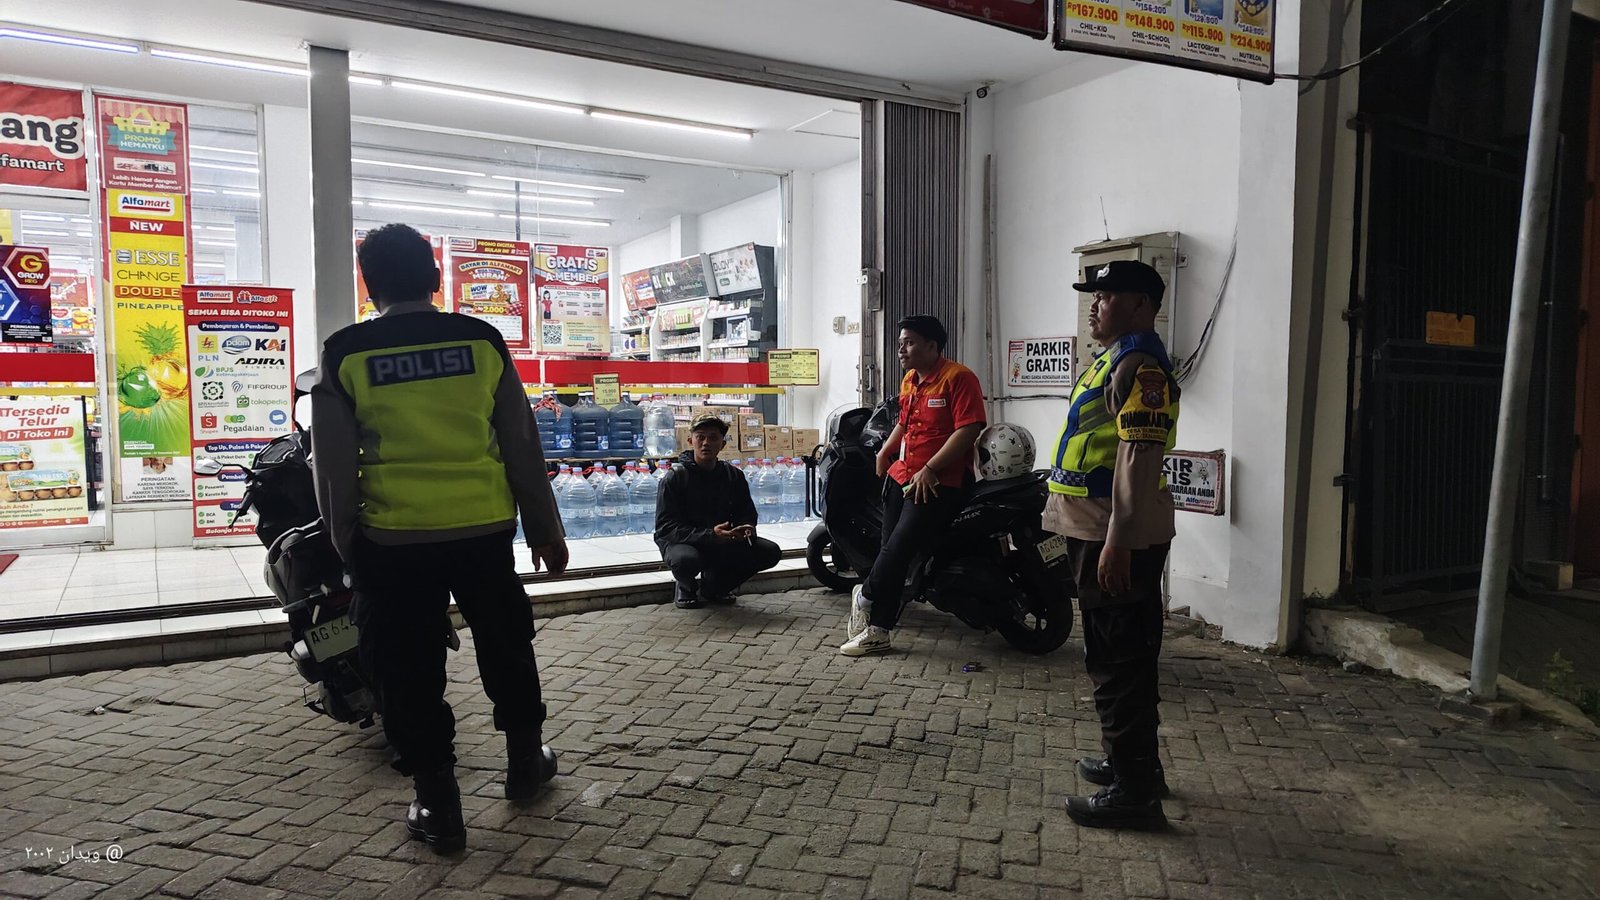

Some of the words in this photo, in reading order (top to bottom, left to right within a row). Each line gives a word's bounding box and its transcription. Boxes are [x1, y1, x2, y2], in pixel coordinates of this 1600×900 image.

[1067, 2, 1119, 22] Rp167.900
[1125, 12, 1175, 32] Rp148.900
[124, 134, 161, 143] PROMO
[120, 141, 165, 151] HEMATKU
[121, 196, 171, 208] Alfamart
[129, 220, 164, 232] NEW
[134, 249, 180, 267] ESSE
[546, 255, 598, 272] GRATIS
[17, 272, 45, 280] GROW
[116, 269, 181, 282] CHANGE
[119, 286, 180, 297] DOUBLE
[117, 302, 184, 311] PINEAPPLE
[1026, 341, 1071, 356] PARKIR
[234, 358, 285, 366] ADIRA
[373, 348, 471, 382] POLISI
[1026, 358, 1070, 372] GRATIS
[4, 404, 70, 417] Tersedia
[18, 416, 58, 427] Telur
[7, 430, 21, 440] Di
[22, 429, 52, 439] Toko
[53, 428, 70, 437] Ini
[223, 424, 265, 433] Pegadaian
[1197, 487, 1215, 498] ANDA
[1185, 496, 1215, 506] Alfamart
[310, 626, 330, 645] AG
